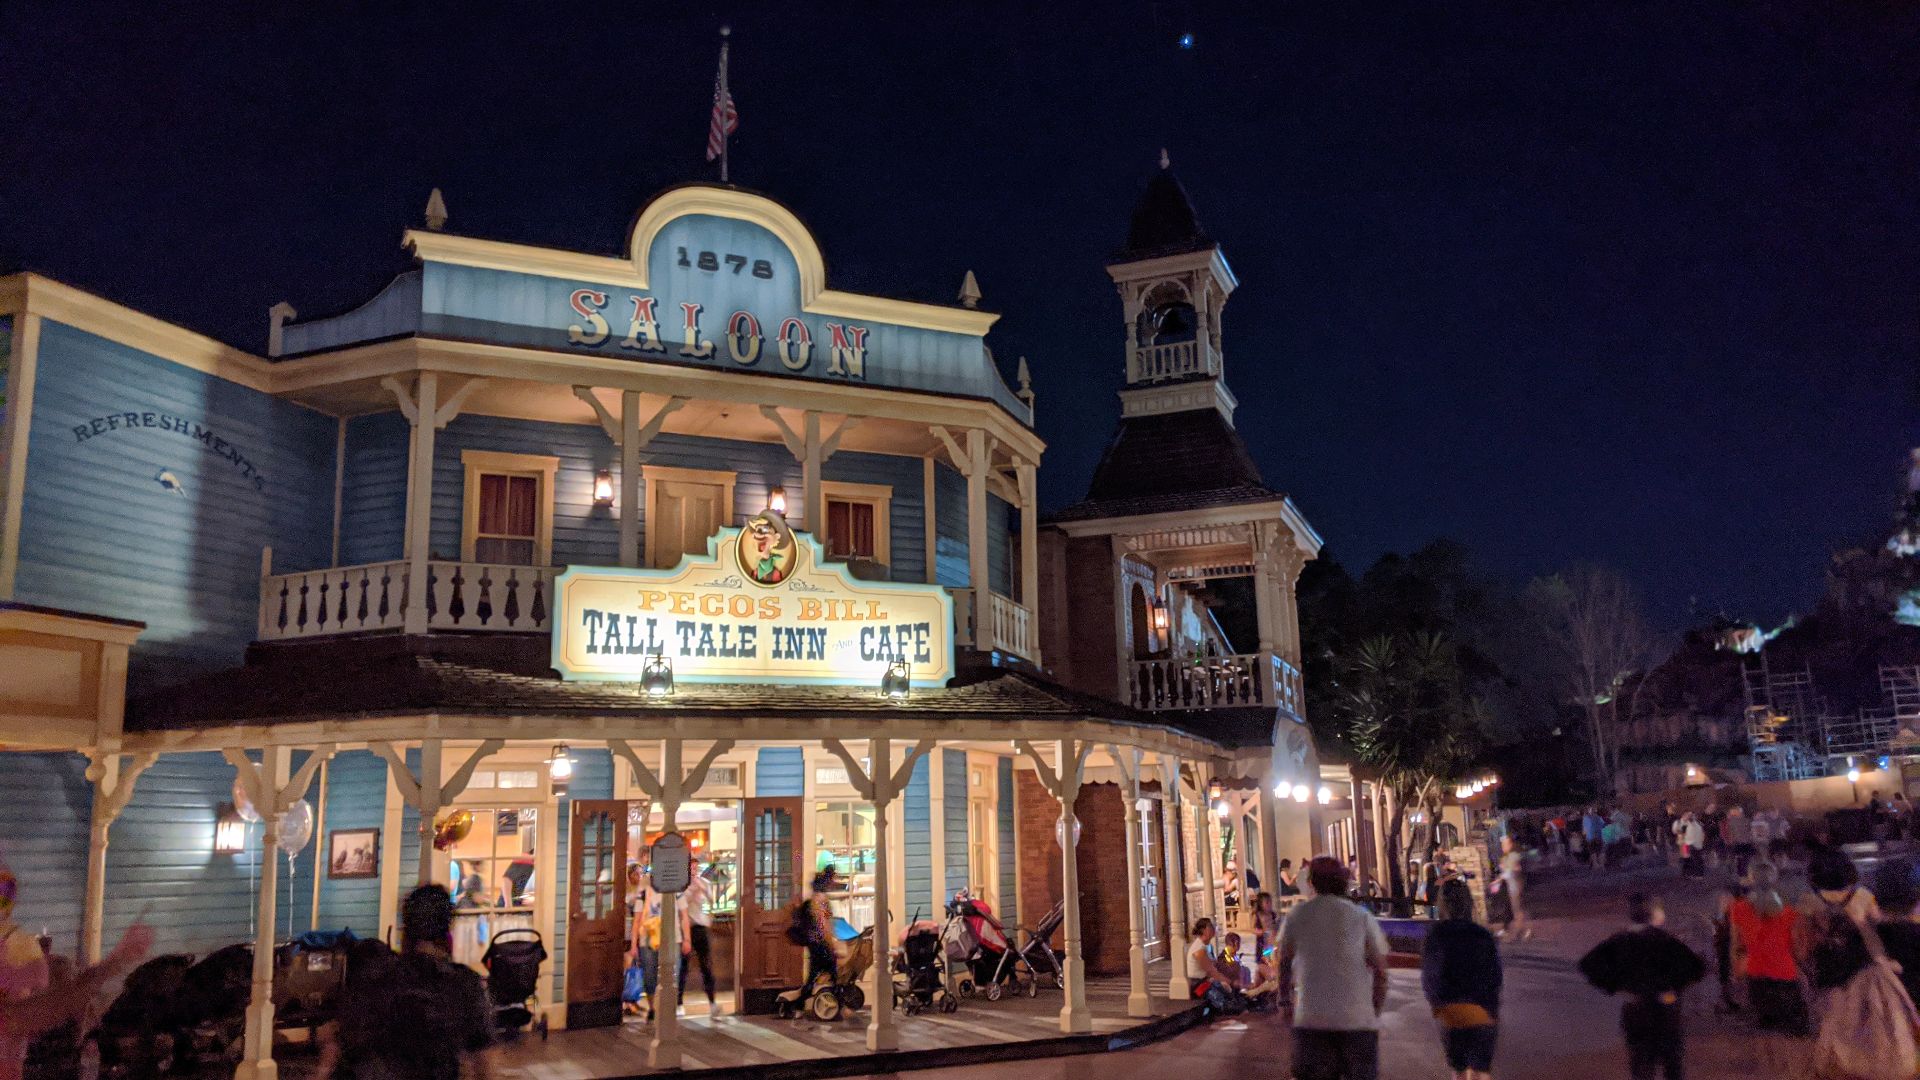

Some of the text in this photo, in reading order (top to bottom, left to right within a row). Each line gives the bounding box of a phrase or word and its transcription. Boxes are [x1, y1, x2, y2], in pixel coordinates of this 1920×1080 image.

[677, 246, 774, 279] 1878
[569, 289, 868, 377] SALOON
[73, 412, 265, 490] REFRESHMENTS
[638, 590, 888, 621] PECOS BILL
[583, 608, 664, 655] TALL
[676, 620, 757, 658] TALE
[772, 626, 827, 660] INN
[860, 622, 930, 663] CAFE
